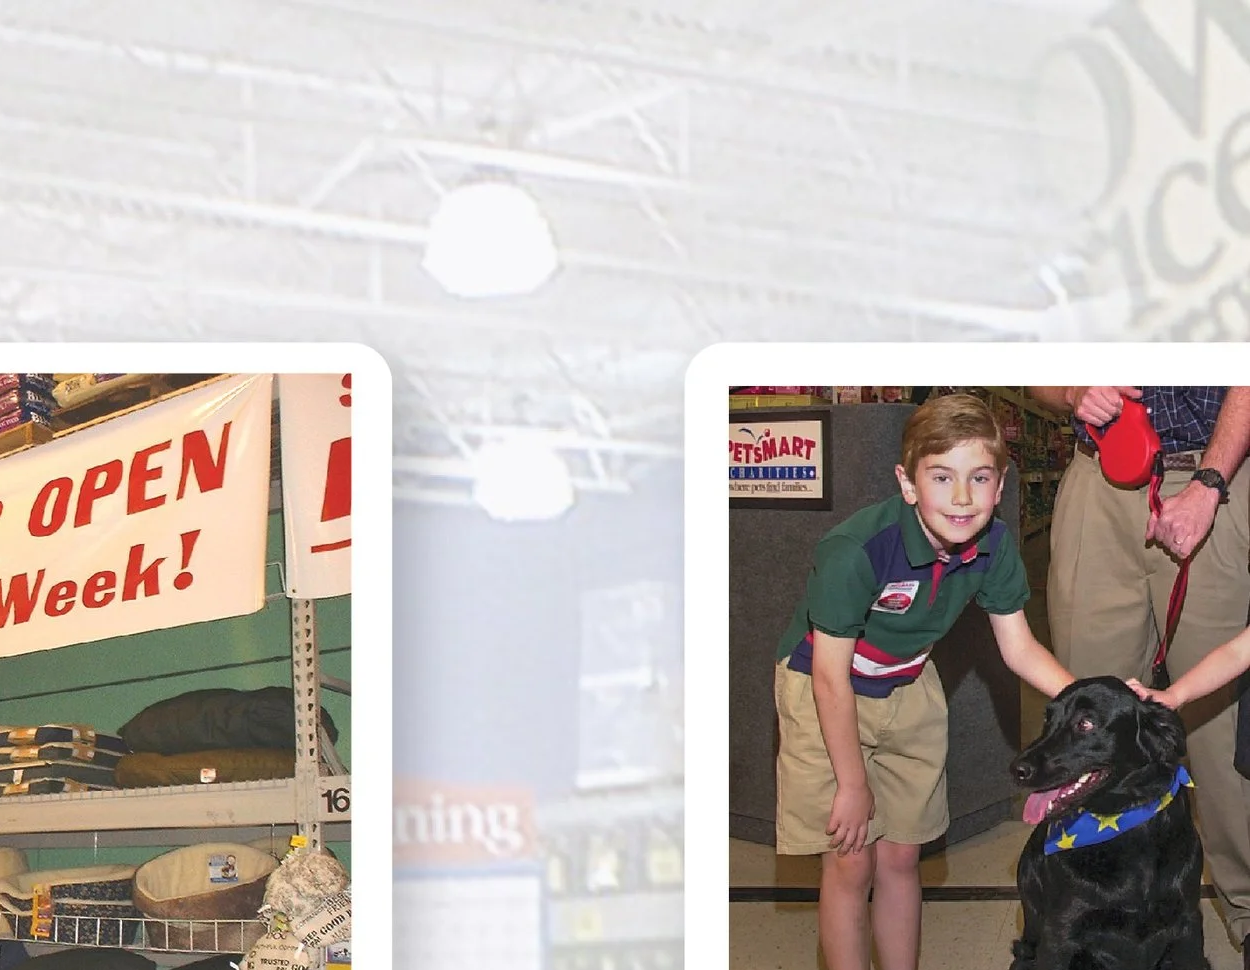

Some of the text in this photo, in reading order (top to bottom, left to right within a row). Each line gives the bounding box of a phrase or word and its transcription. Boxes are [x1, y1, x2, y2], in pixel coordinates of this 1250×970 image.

[28, 421, 233, 537] OPEN
[730, 466, 807, 479] CHARITIES
[321, 787, 351, 813] 16
[396, 790, 525, 857] ning
[319, 913, 346, 935] GOOD
[261, 958, 290, 966] TRUSTED
